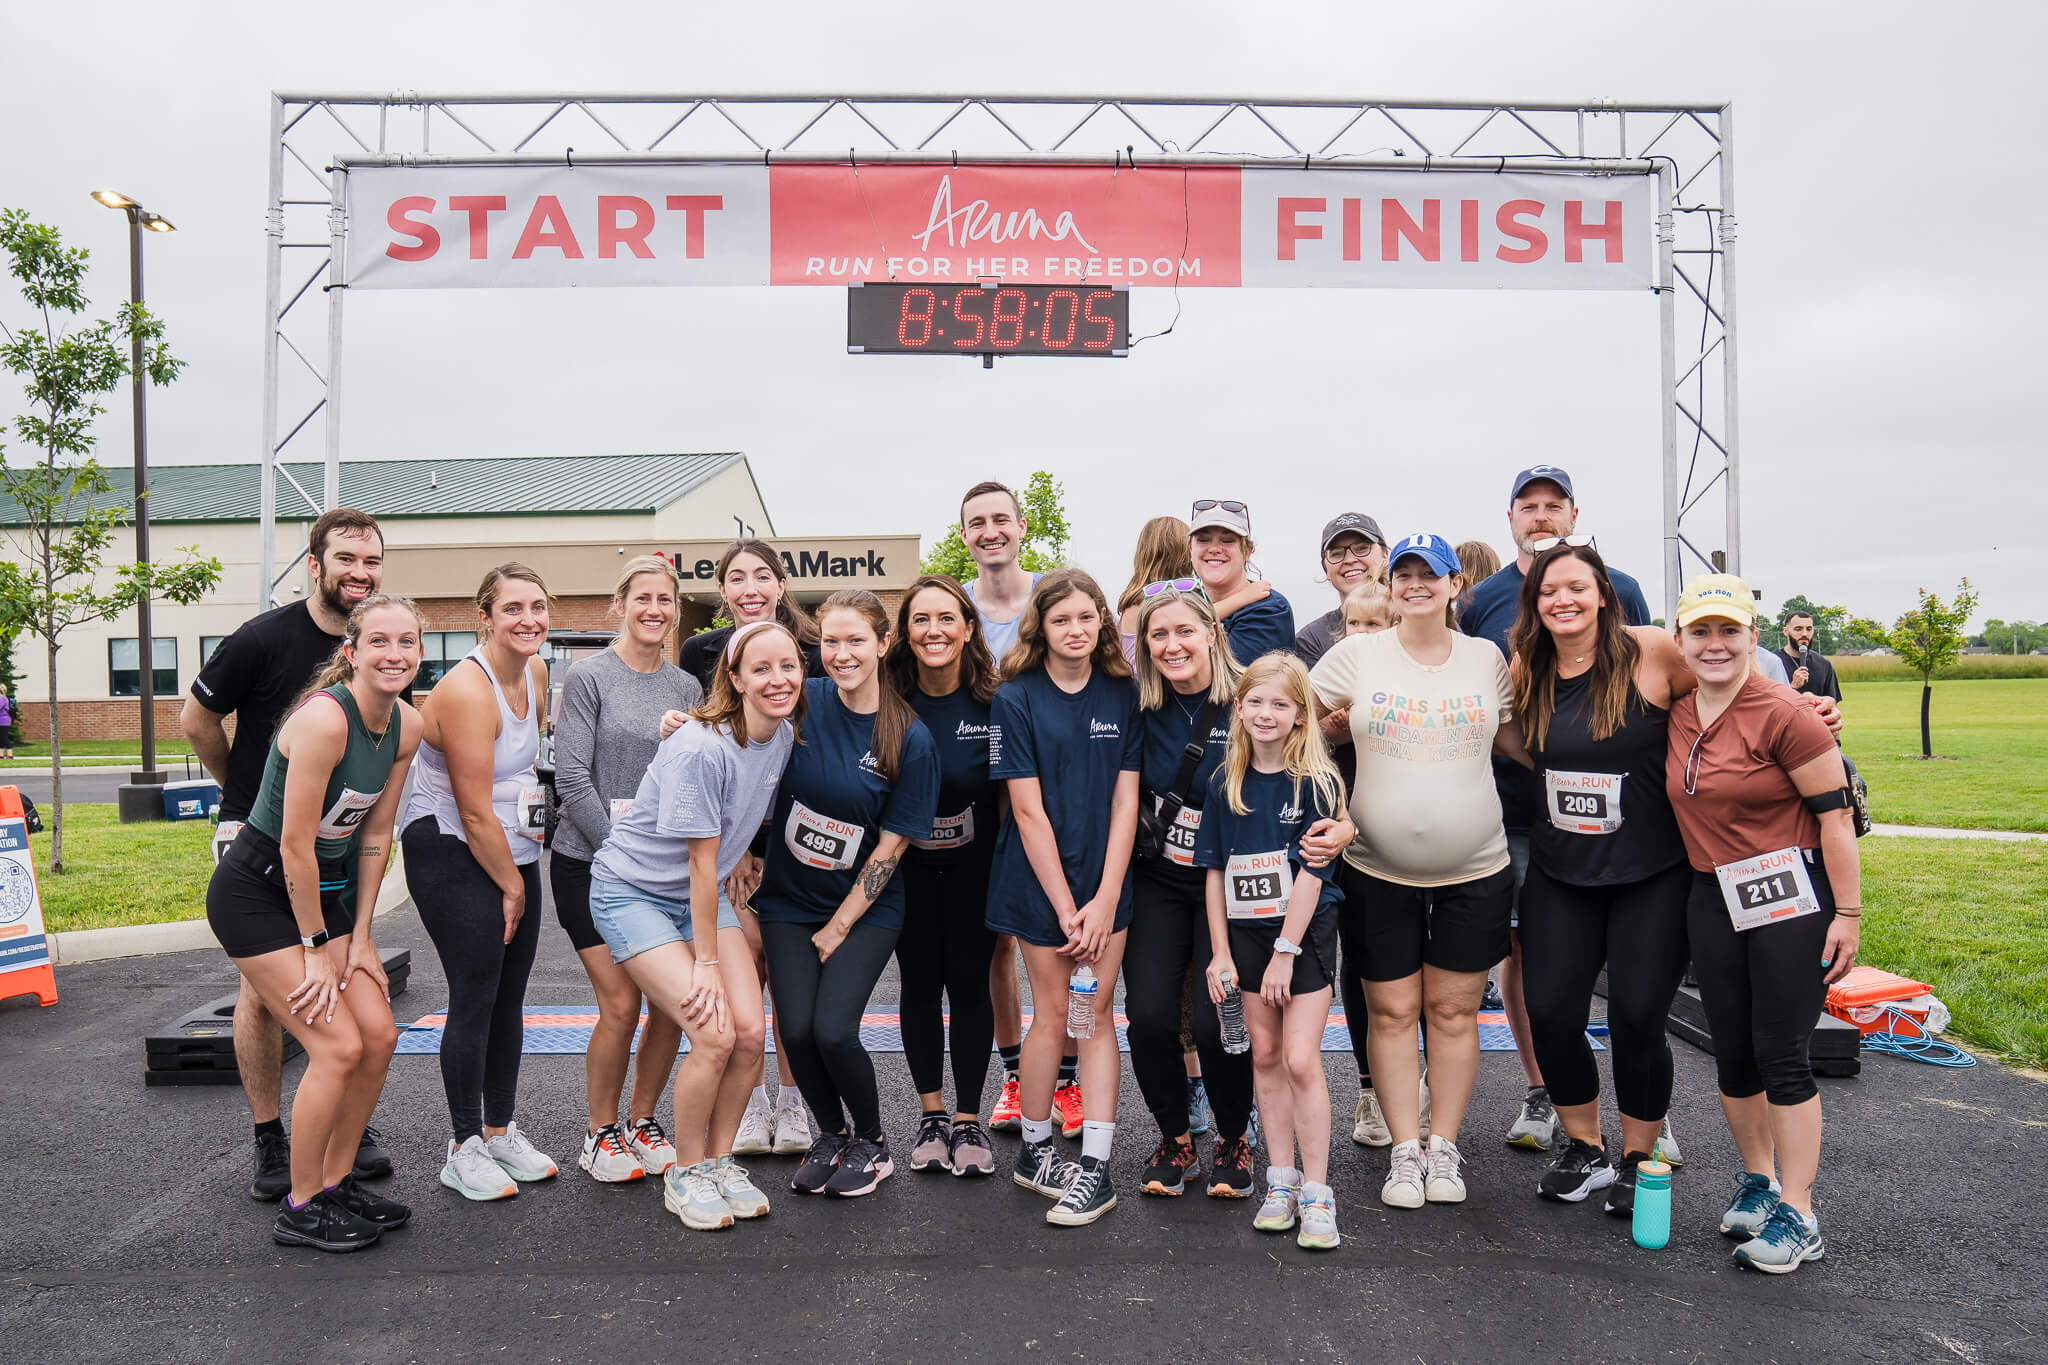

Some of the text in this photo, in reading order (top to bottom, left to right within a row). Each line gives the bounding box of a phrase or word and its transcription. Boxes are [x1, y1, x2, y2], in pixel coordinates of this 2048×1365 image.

[385, 194, 723, 261] START
[1277, 197, 1624, 263] FINISH
[805, 257, 1201, 277] RUN FOR HER FREEDOM
[898, 288, 1115, 348] 8:58:05
[1372, 691, 1482, 713] GIRLS JUST
[1370, 705, 1486, 728] WANNA HAVE
[1582, 776, 1611, 788] RUN
[1564, 795, 1598, 814] 209
[939, 813, 966, 825] RUN
[1183, 810, 1200, 824] RU
[825, 820, 855, 837] RUN
[1166, 825, 1195, 847] 215
[802, 831, 836, 854] 499
[1251, 855, 1281, 869] RUN
[1760, 852, 1793, 870] RUN
[1239, 878, 1272, 897] 213
[1747, 877, 1785, 904] 211
